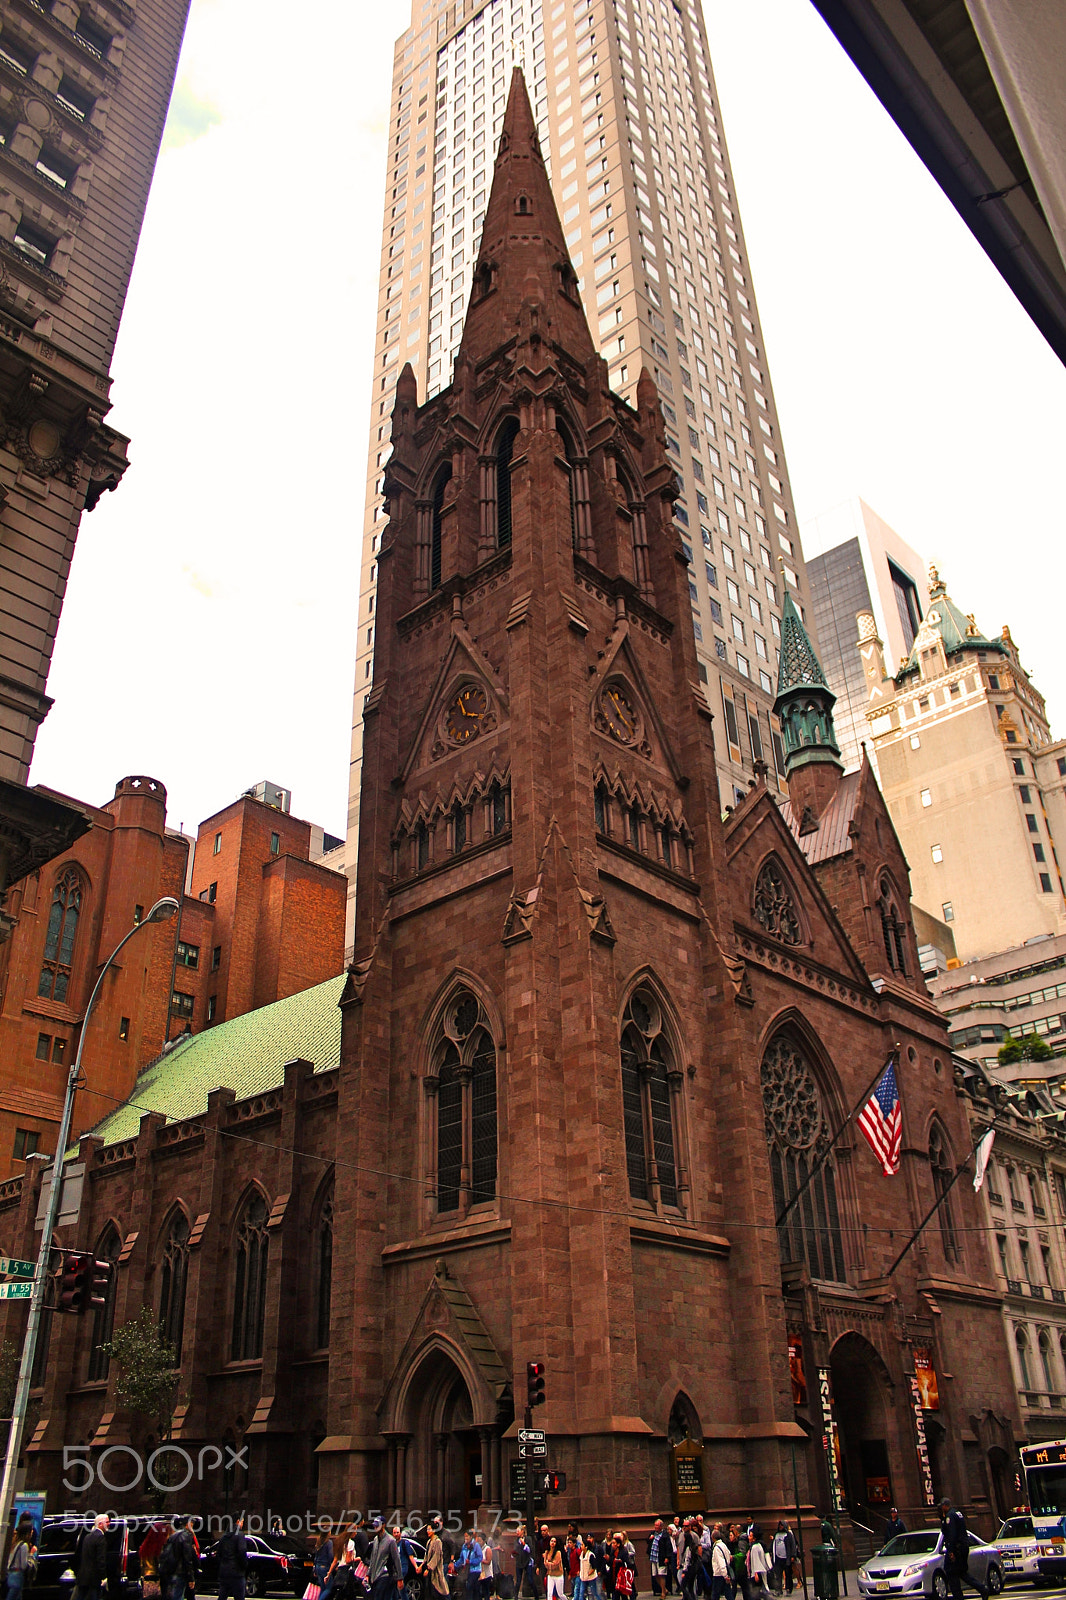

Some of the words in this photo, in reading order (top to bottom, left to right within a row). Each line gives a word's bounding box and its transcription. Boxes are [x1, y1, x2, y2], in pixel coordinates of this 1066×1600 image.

[13, 1262, 19, 1274] 5
[12, 1284, 17, 1292] W
[20, 1283, 30, 1292] 55
[1036, 1449, 1049, 1463] M4
